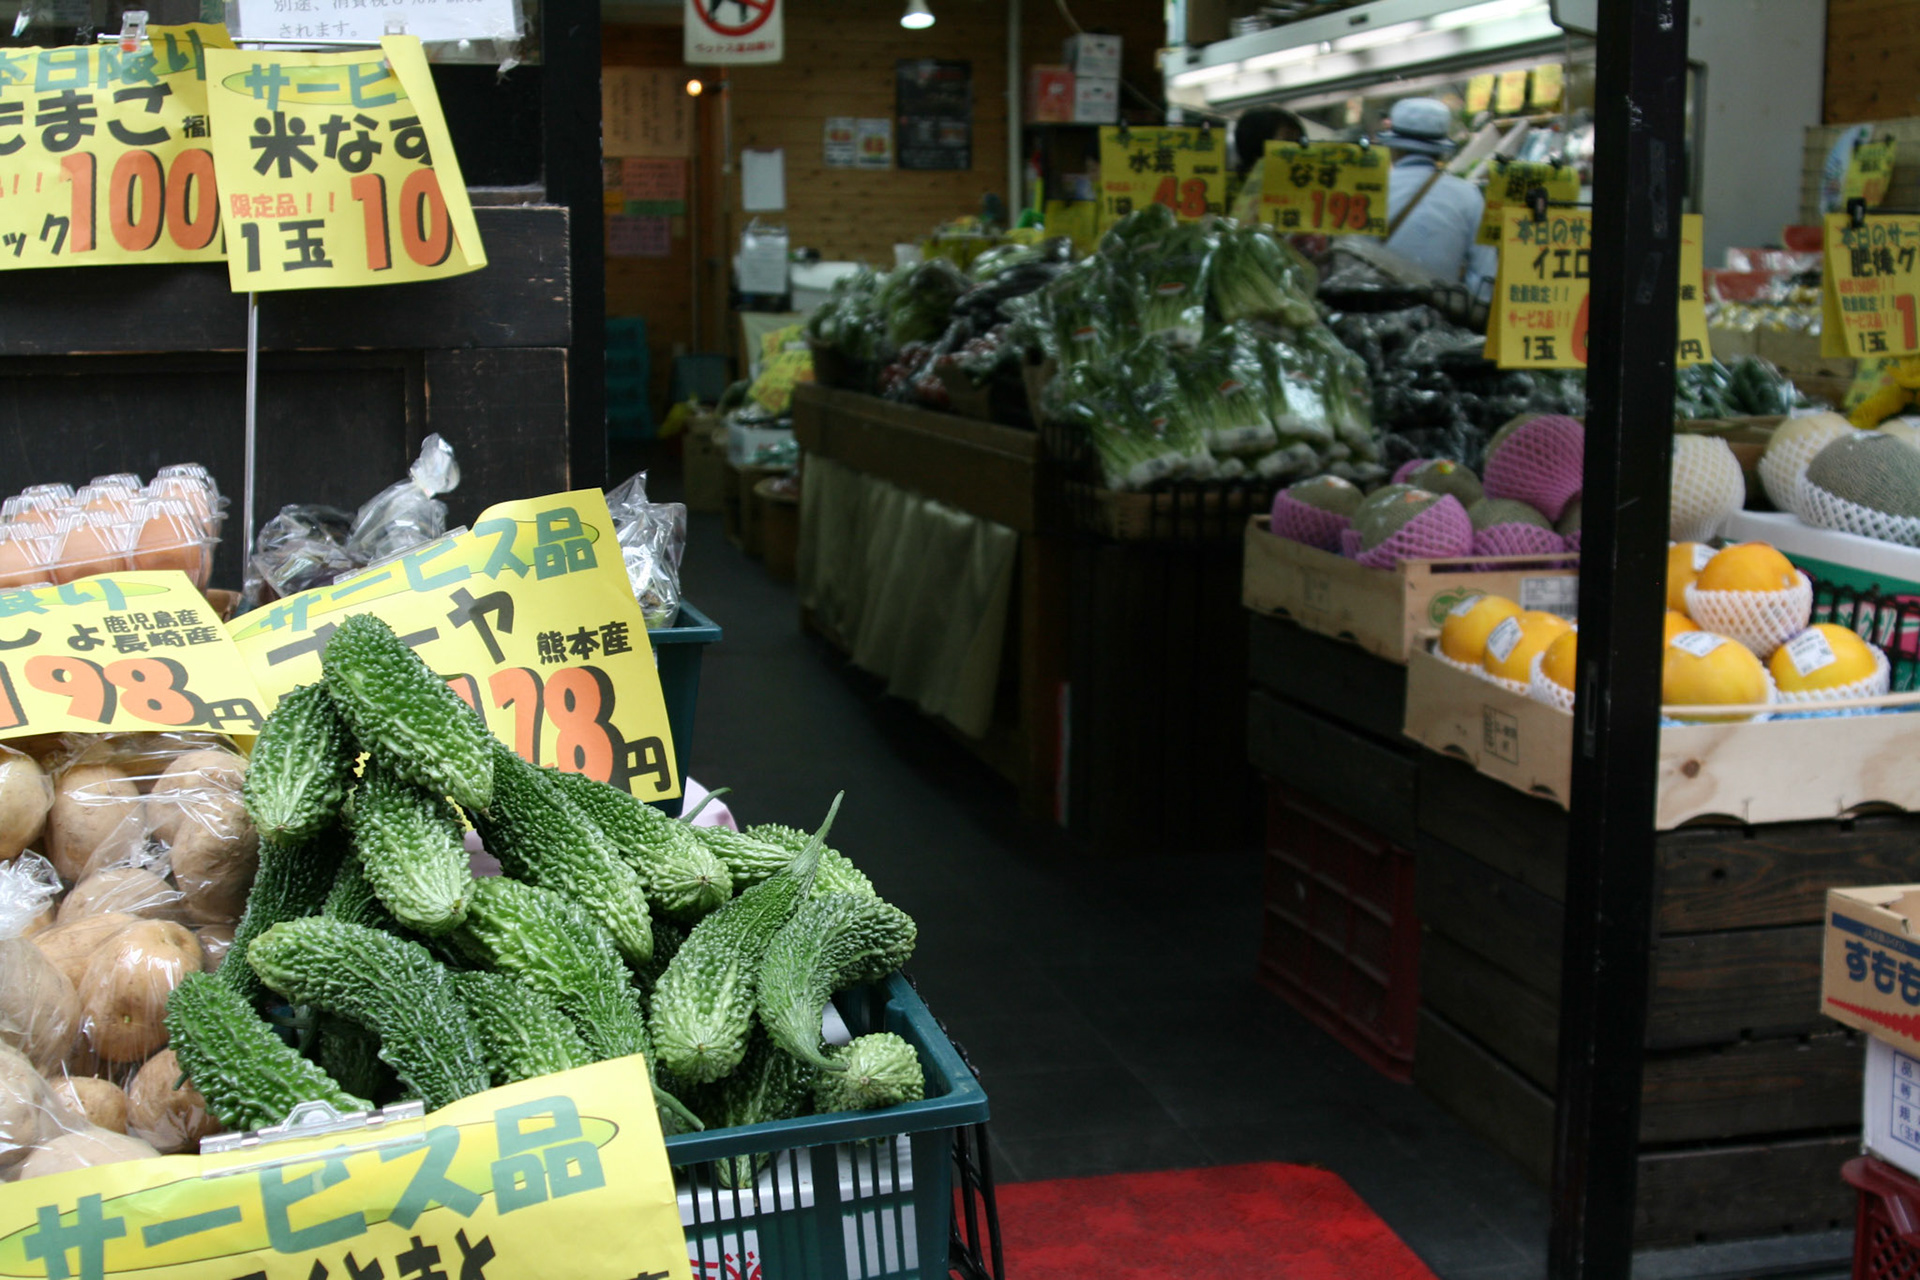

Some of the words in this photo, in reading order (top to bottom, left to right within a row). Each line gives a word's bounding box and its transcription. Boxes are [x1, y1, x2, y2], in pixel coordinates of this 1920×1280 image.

[279, 20, 358, 38] されます。
[183, 115, 211, 138] 福
[240, 219, 334, 273] 1玉
[1517, 217, 1592, 246] 本日のサ
[259, 506, 598, 632] サービス品
[103, 608, 204, 634] 鹿児島産
[112, 625, 223, 654] 長崎産
[536, 621, 633, 665] 熊本産
[1845, 938, 1920, 1005] すもも
[22, 1095, 607, 1280] サービス品
